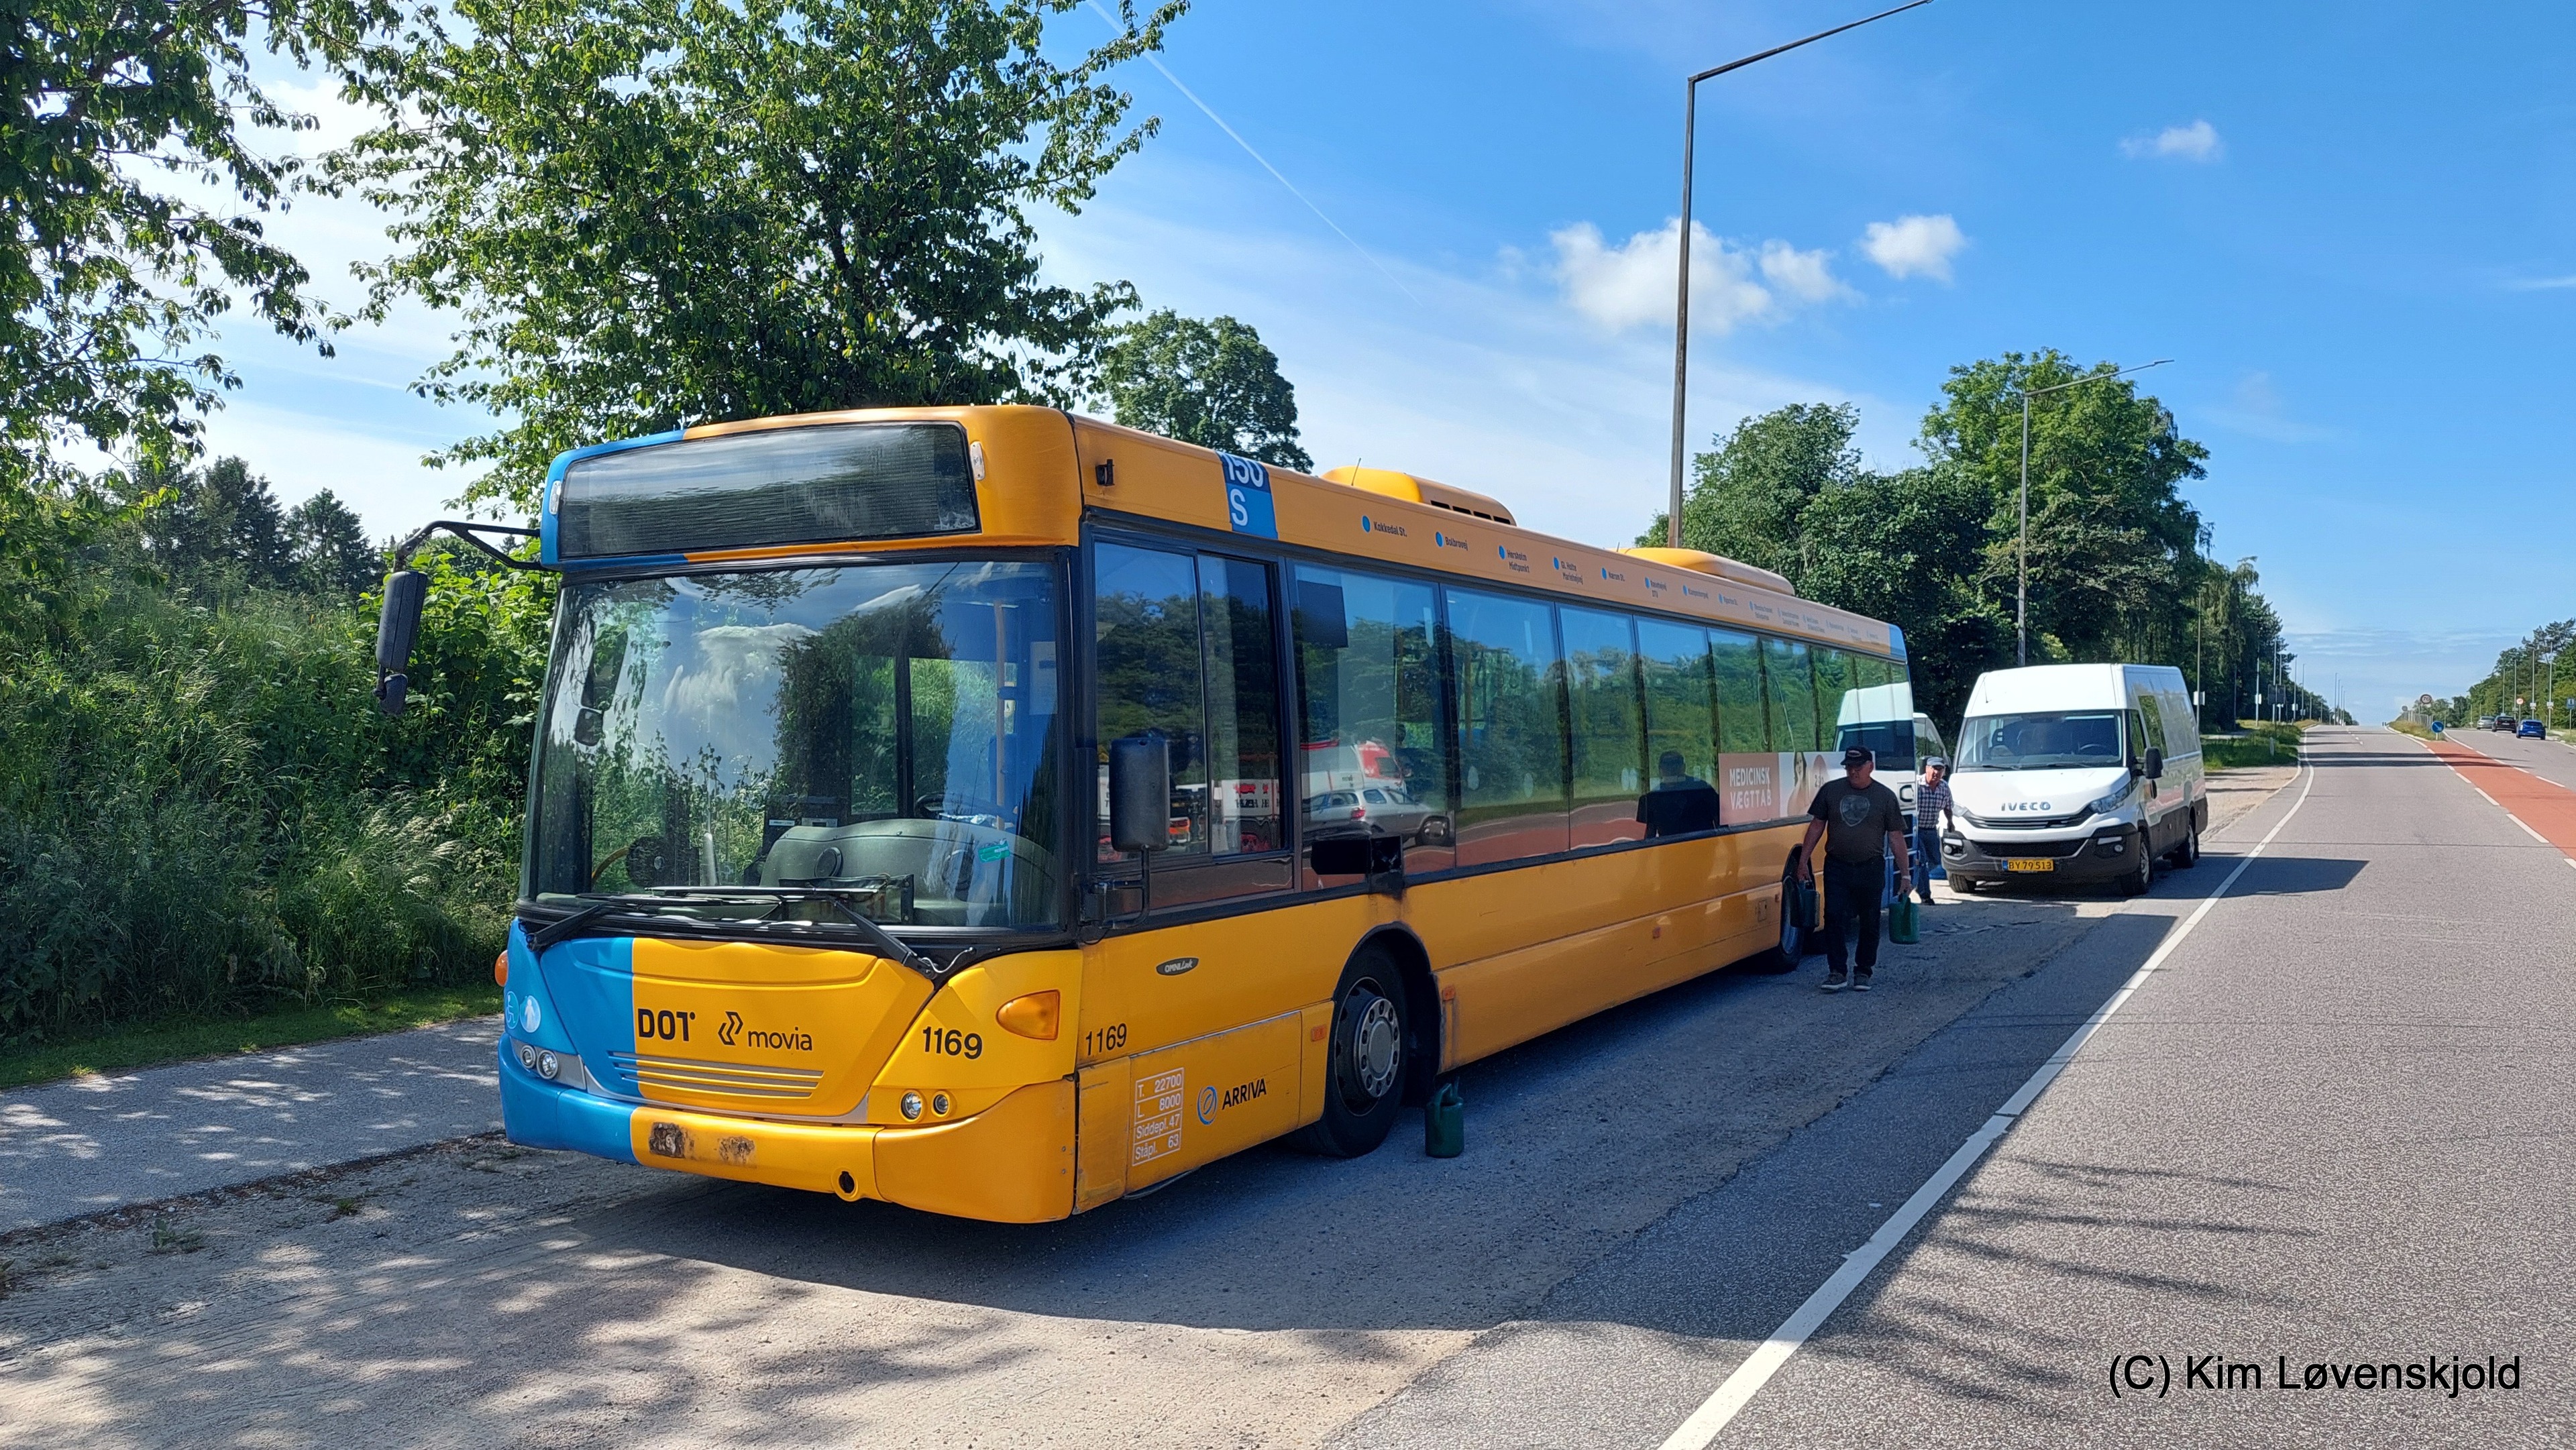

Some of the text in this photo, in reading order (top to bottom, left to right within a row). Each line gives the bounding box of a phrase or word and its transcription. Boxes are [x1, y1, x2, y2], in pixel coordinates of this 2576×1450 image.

[1220, 453, 1264, 488] 150
[1230, 488, 1248, 526] S
[1373, 521, 1407, 537] Kokkedal St.
[1445, 537, 1468, 551] Bolbrovej
[1729, 767, 1770, 787] MEDICINSK
[1730, 789, 1772, 810] VÆGTTAB
[2001, 801, 2051, 812] IVECO
[638, 1008, 696, 1042] DOT
[747, 1026, 813, 1051] movia
[922, 1026, 983, 1060] 1169
[1085, 1023, 1127, 1056] 1169
[1154, 1073, 1182, 1093] 22700
[1222, 1078, 1267, 1110] ARRIVA
[1159, 1093, 1181, 1111] 8000
[1136, 1113, 1181, 1139] Siddepl. 47
[1135, 1133, 1179, 1160] Ståpl. 63
